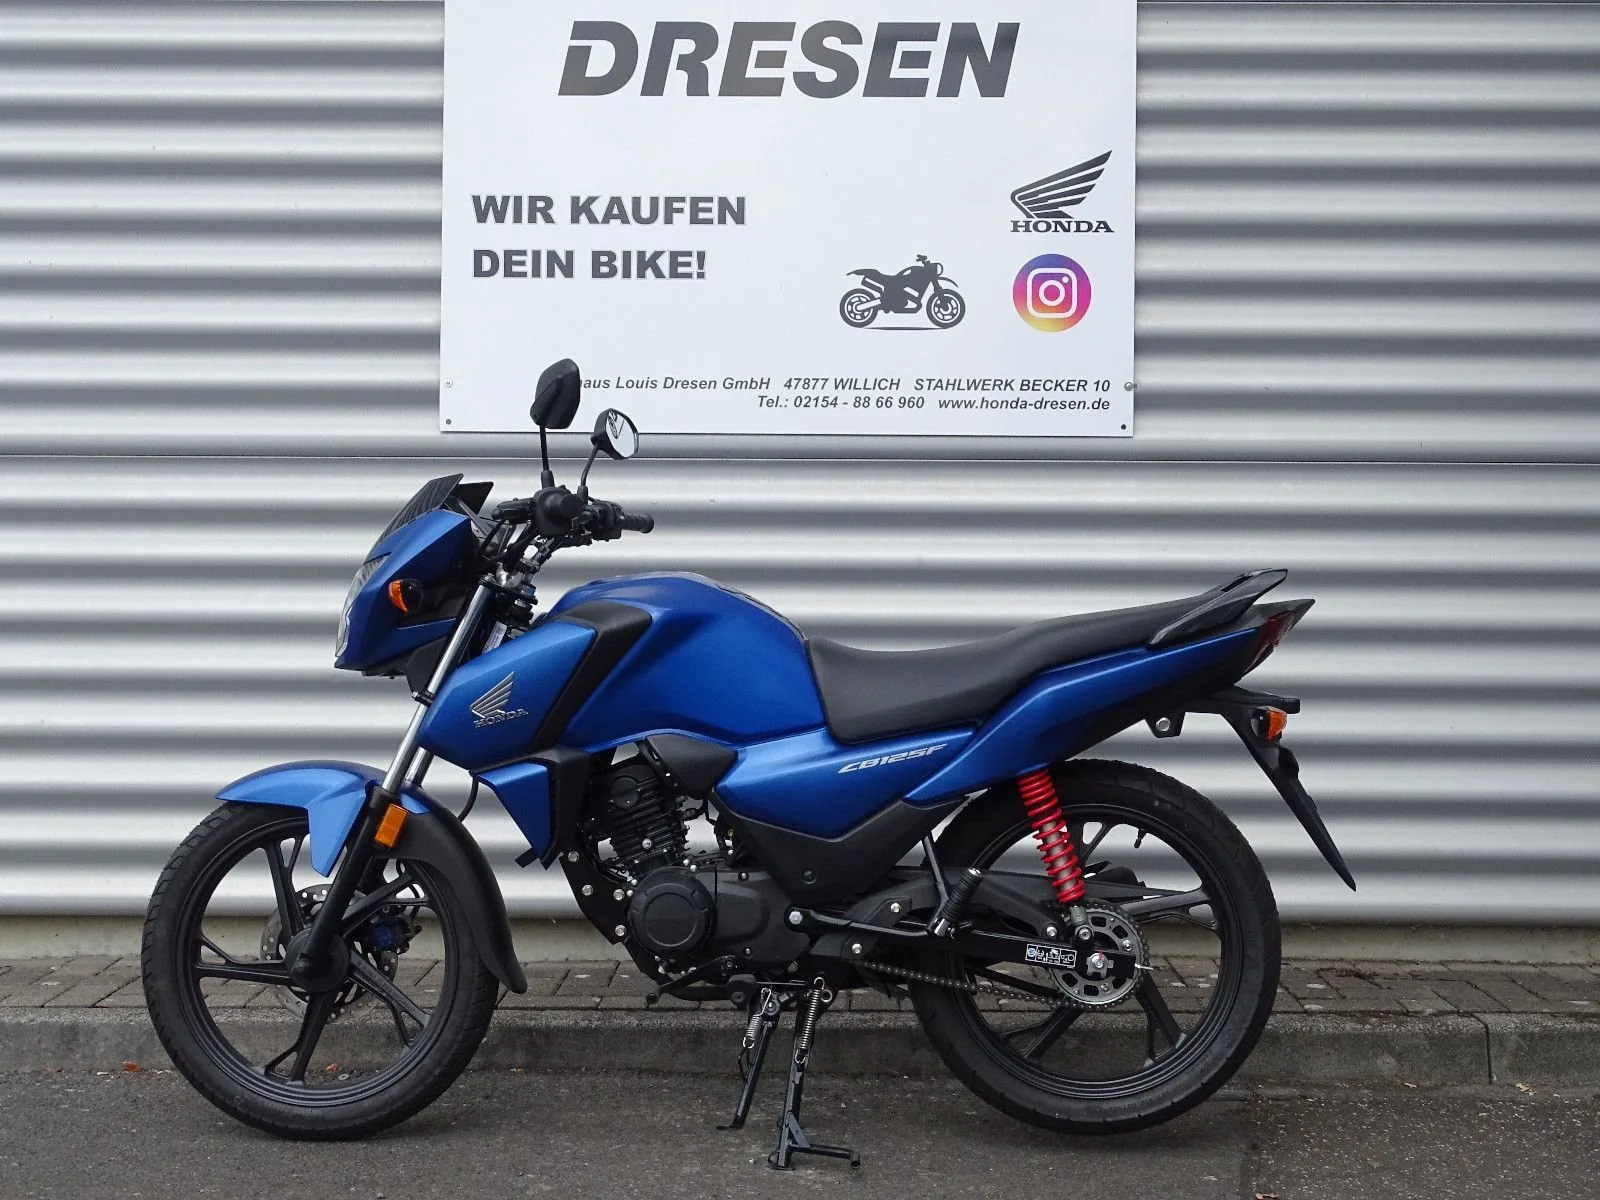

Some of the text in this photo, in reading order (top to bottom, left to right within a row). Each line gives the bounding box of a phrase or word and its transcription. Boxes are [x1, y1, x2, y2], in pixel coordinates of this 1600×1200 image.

[558, 20, 1021, 98] DRESEN
[472, 195, 746, 224] WIR KAUFEN
[1011, 219, 1115, 233] HONDA
[474, 249, 706, 279] DEIN BIKE!
[580, 376, 1111, 392] aus Louis Dresen GmbH 47877 WILLICH STAHLWERK BECKER 10
[757, 395, 789, 408] Tel.:
[793, 395, 839, 408] 02154
[852, 396, 871, 409] 88
[875, 396, 894, 409] 66
[897, 396, 925, 409] 960
[938, 396, 1110, 410] www.honda-dresen.de
[838, 743, 948, 774] CB125F
